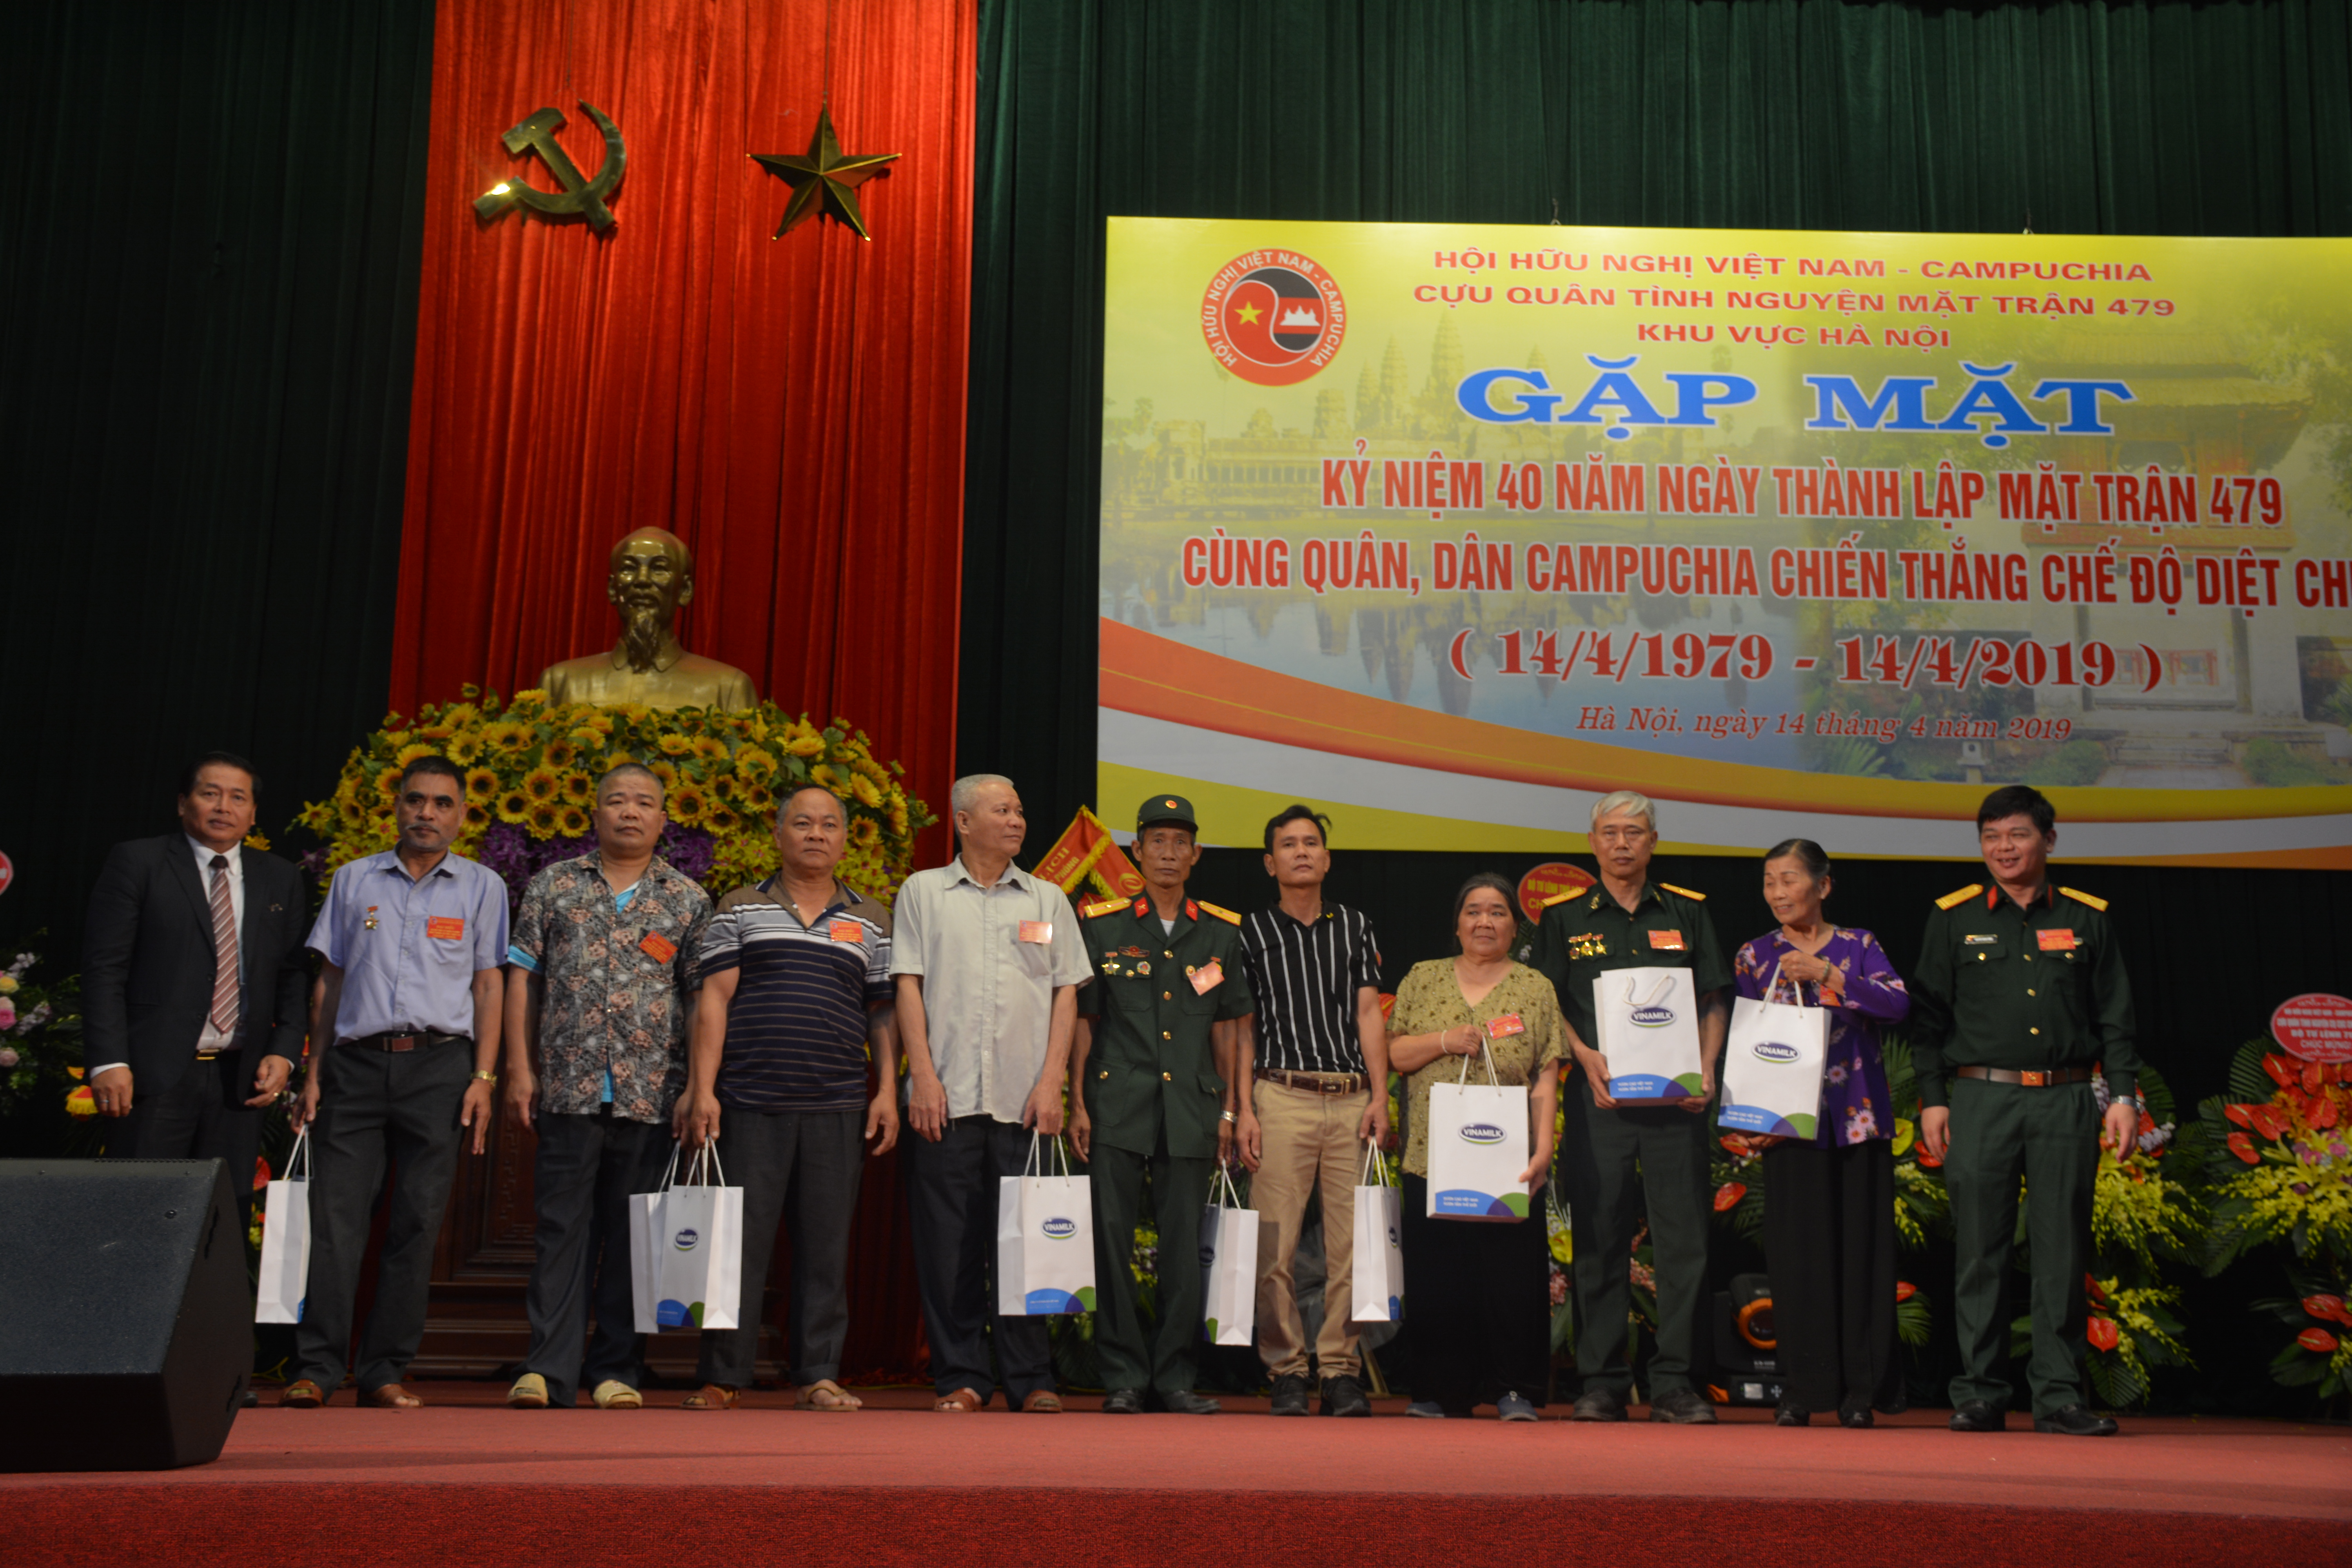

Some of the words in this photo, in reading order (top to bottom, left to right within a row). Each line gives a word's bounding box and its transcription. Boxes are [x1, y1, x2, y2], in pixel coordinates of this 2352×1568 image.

[1237, 251, 1273, 270] VIỆT
[1278, 252, 1315, 274] NAM
[1435, 247, 1496, 274] HỘI
[1510, 248, 1588, 271] HỮU
[1603, 254, 1692, 279] NGHỊ
[1705, 252, 1786, 280] VIỆT
[1798, 258, 1885, 278] NAM
[1920, 260, 2152, 281] CAMPUCHIA
[1208, 265, 1240, 301] NGHỊ
[1414, 283, 1493, 309] CỰU
[1506, 283, 1615, 306] QUÂN
[1627, 285, 1713, 308] TÌNH
[1727, 289, 1885, 316] NGUYỆN
[1898, 290, 1981, 319] MẶT
[1991, 292, 2095, 320] TRẬN
[2107, 298, 2175, 317] 479
[1310, 279, 1344, 367] CAMPUCHIA
[1638, 323, 1715, 343] KHU
[1727, 324, 1806, 350] VỰC
[1819, 323, 1872, 346] HÀ
[1884, 324, 1950, 353] NỘI
[1212, 341, 1238, 367] HỘI
[1458, 355, 1757, 439] GẶP
[1806, 363, 2133, 448] MẶT
[1324, 439, 1370, 506] KỶ
[1385, 451, 1483, 519] NIỆM
[1497, 463, 1542, 510] 40
[1556, 454, 1644, 512] NĂM
[1659, 457, 1760, 514] NGÀY
[1773, 459, 1900, 517] THÀNH
[1914, 461, 1984, 529] LẬP
[1999, 463, 2081, 531] MẶT
[2093, 465, 2197, 534] TRẬN
[2210, 477, 2282, 525] 479
[1184, 528, 1288, 587] CÙNG
[1303, 531, 1419, 595] QUÂN,
[1434, 532, 1512, 590] DÂN
[1527, 544, 1759, 595] CAMPUCHIA
[1771, 534, 1887, 598] CHIẾN
[1899, 537, 2028, 602] THẮNG
[2042, 538, 2117, 603] CHẾ
[2129, 546, 2182, 615] ĐỘ
[2196, 548, 2280, 617] DIỆT
[2295, 559, 2352, 608] CH
[1499, 630, 1773, 682] 14/4/1979
[1841, 637, 2116, 689] 14/4/2019
[1577, 706, 1615, 730] Hà
[1626, 707, 1682, 738] Nội,
[1694, 708, 1768, 739] ngày
[1776, 713, 1804, 734] 14
[1816, 712, 1901, 742] tháng
[1910, 716, 1925, 736] 4
[1935, 715, 1997, 738] năm
[2007, 717, 2071, 739] 2019
[1633, 1011, 1671, 1021] VINAMILK
[1757, 1045, 1795, 1057] VINAMILK
[1464, 1128, 1501, 1138] VINAMILK
[1044, 1222, 1074, 1231] VINAMILK
